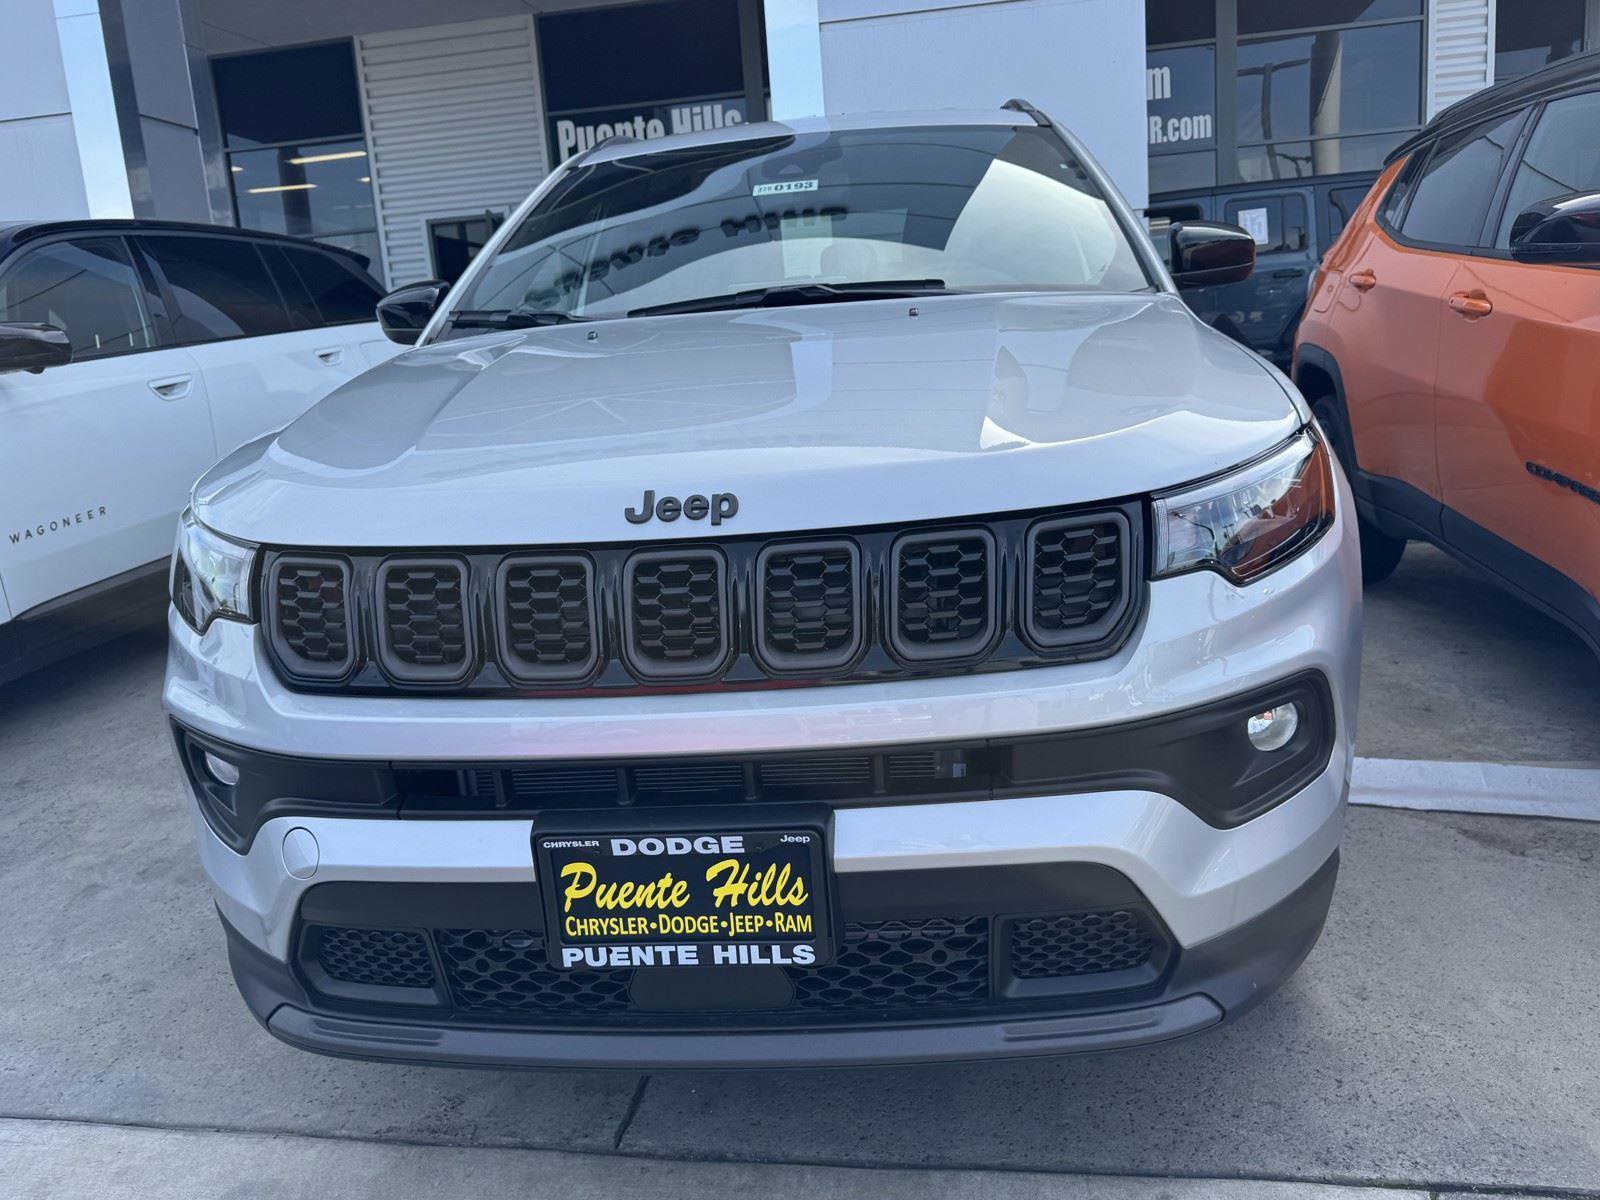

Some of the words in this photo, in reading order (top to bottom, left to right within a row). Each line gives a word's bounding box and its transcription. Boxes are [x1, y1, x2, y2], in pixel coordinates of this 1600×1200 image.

[8, 505, 107, 545] WAGONEER
[624, 489, 739, 526] Jeep
[543, 839, 600, 849] CHRYSLER
[610, 835, 746, 857] DODGE
[779, 834, 811, 845] Jeep
[560, 861, 691, 913] Puente
[705, 858, 809, 909] Hills
[561, 945, 699, 968] PUENTE
[712, 944, 816, 965] HILLS
